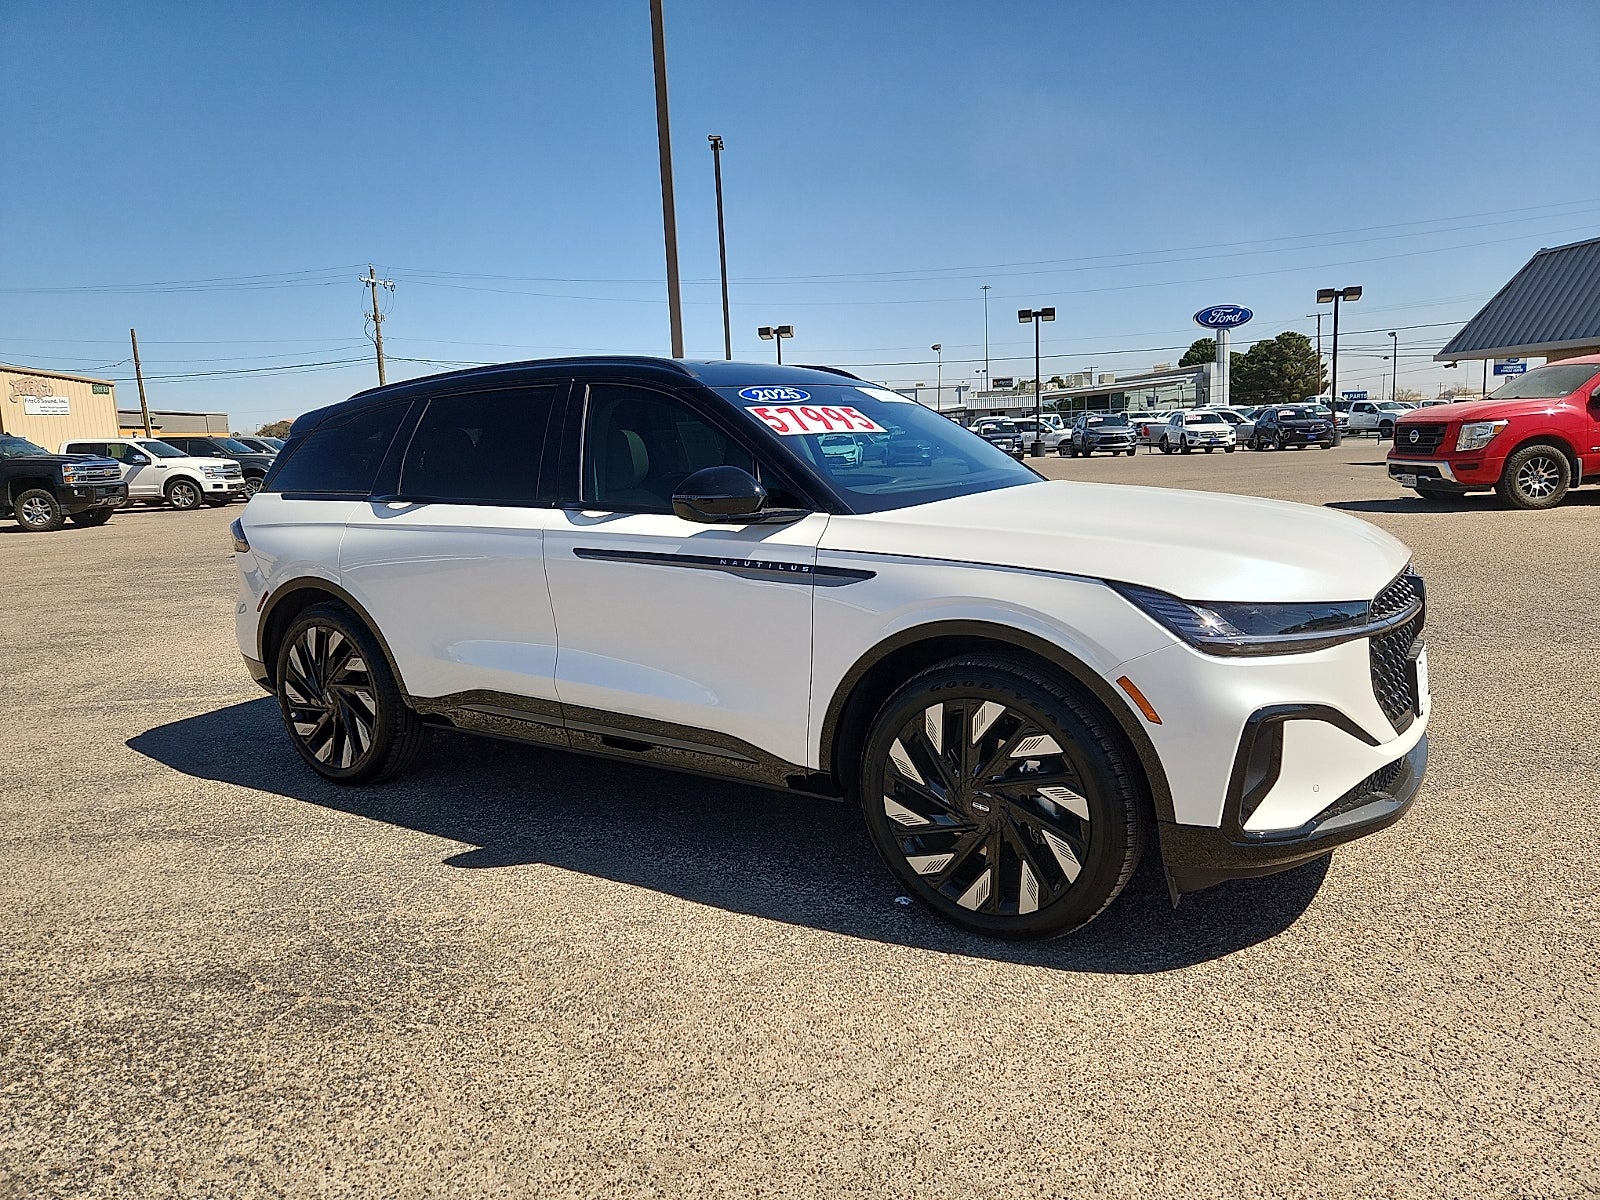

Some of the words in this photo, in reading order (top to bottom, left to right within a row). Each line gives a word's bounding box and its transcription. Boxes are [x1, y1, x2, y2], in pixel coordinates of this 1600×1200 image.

[1208, 308, 1242, 323] Ford
[752, 388, 801, 401] 2025
[752, 407, 875, 432] 57995
[719, 559, 809, 572] NAUTILUS
